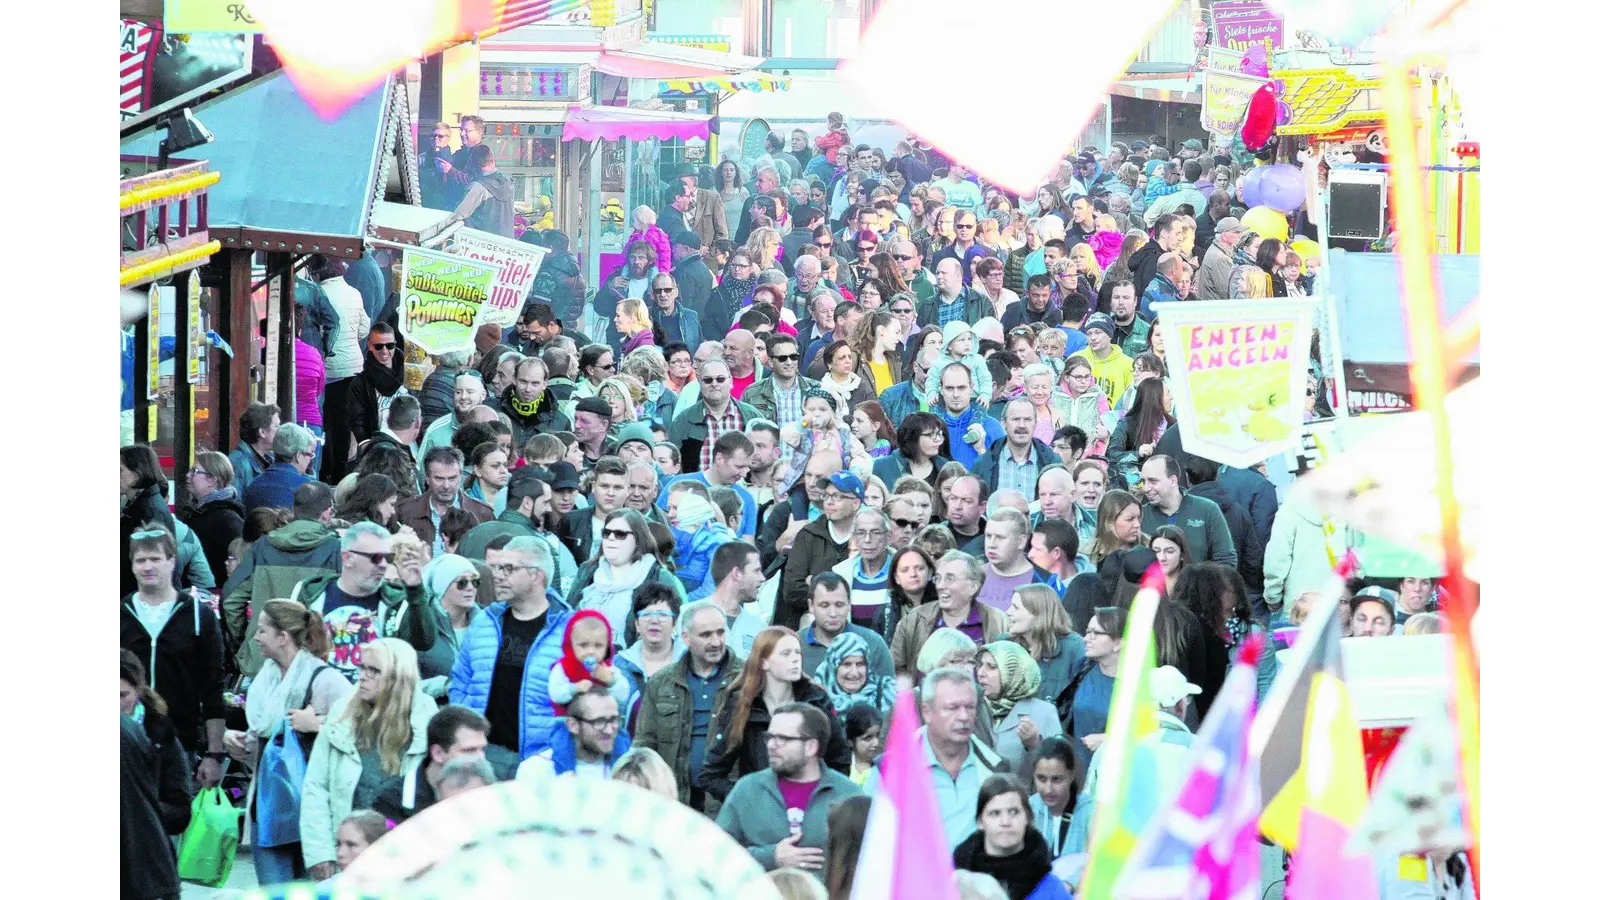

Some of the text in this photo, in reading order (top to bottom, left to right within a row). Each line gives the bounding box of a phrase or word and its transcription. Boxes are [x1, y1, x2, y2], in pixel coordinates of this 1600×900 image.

[460, 236, 534, 262] HAUSGEMACHTE
[406, 268, 488, 304] Süßkartoffel-
[405, 293, 477, 334] Pommes
[1190, 323, 1289, 350] ENTEN-
[1187, 344, 1289, 371] ANGELN
